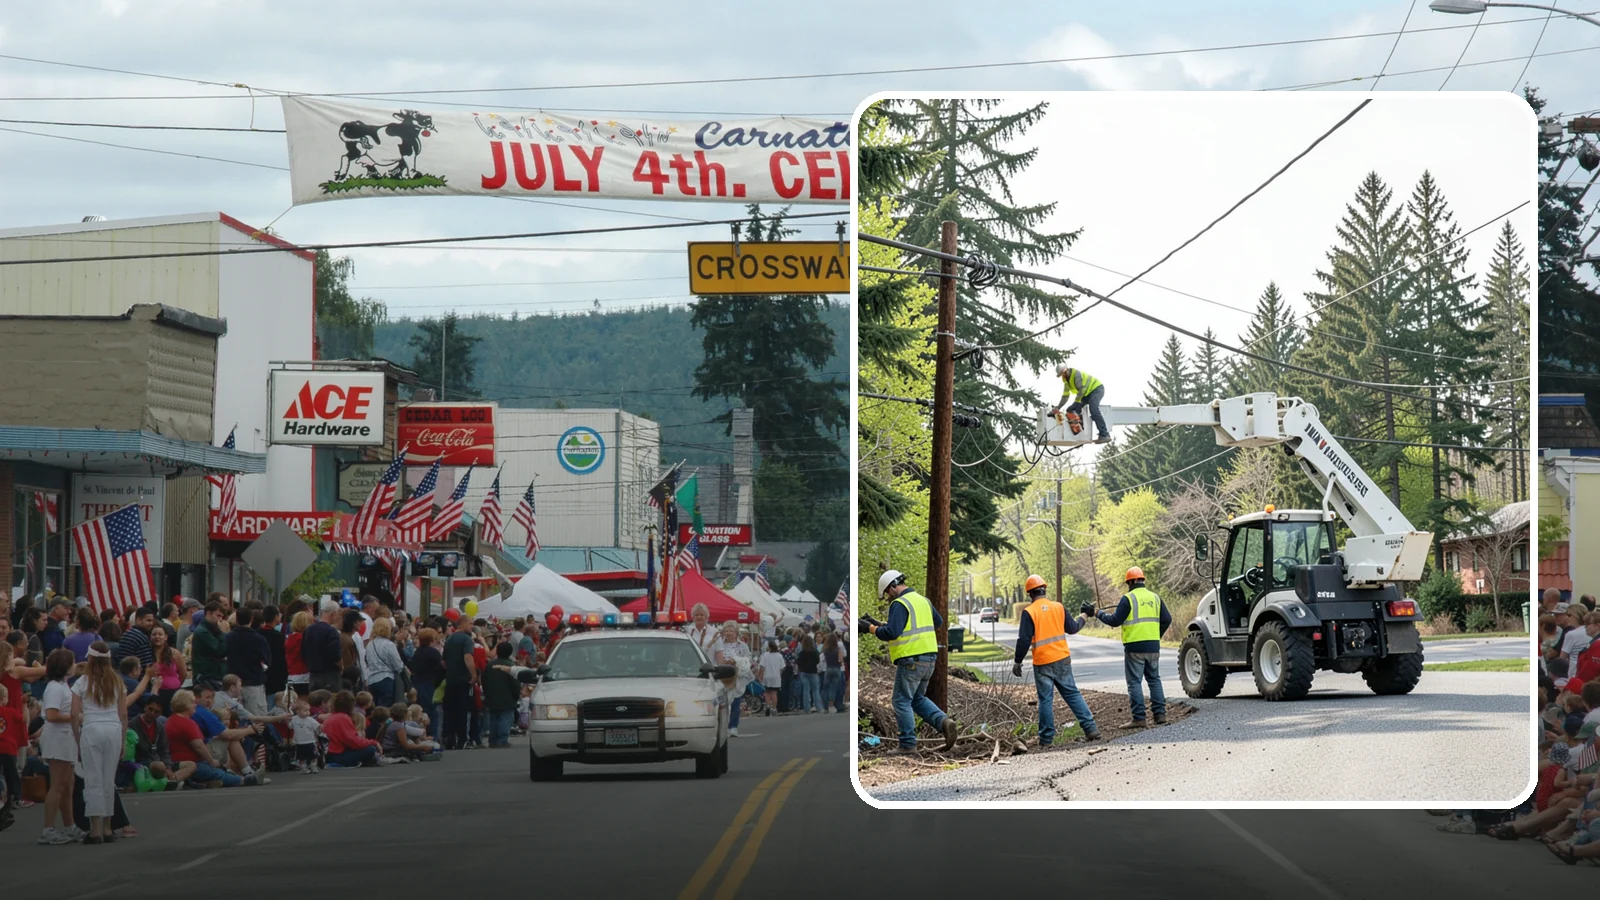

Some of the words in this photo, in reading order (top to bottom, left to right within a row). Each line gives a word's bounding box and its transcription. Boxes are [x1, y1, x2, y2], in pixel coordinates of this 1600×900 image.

[695, 121, 850, 149] Carnat
[482, 141, 605, 193] JULY
[632, 150, 746, 198] 4th.
[697, 254, 850, 280] CROSSWA
[282, 380, 374, 420] ACE
[406, 409, 453, 422] CEDAR
[283, 421, 371, 437] Hardware
[416, 428, 477, 447] Coca-Cola
[353, 467, 386, 480] Simpl
[83, 485, 94, 494] St.
[95, 485, 124, 495] Vincent
[126, 485, 135, 495] de
[137, 486, 155, 495] Paul
[688, 526, 742, 535] CRNATION
[699, 535, 730, 543] GLASS
